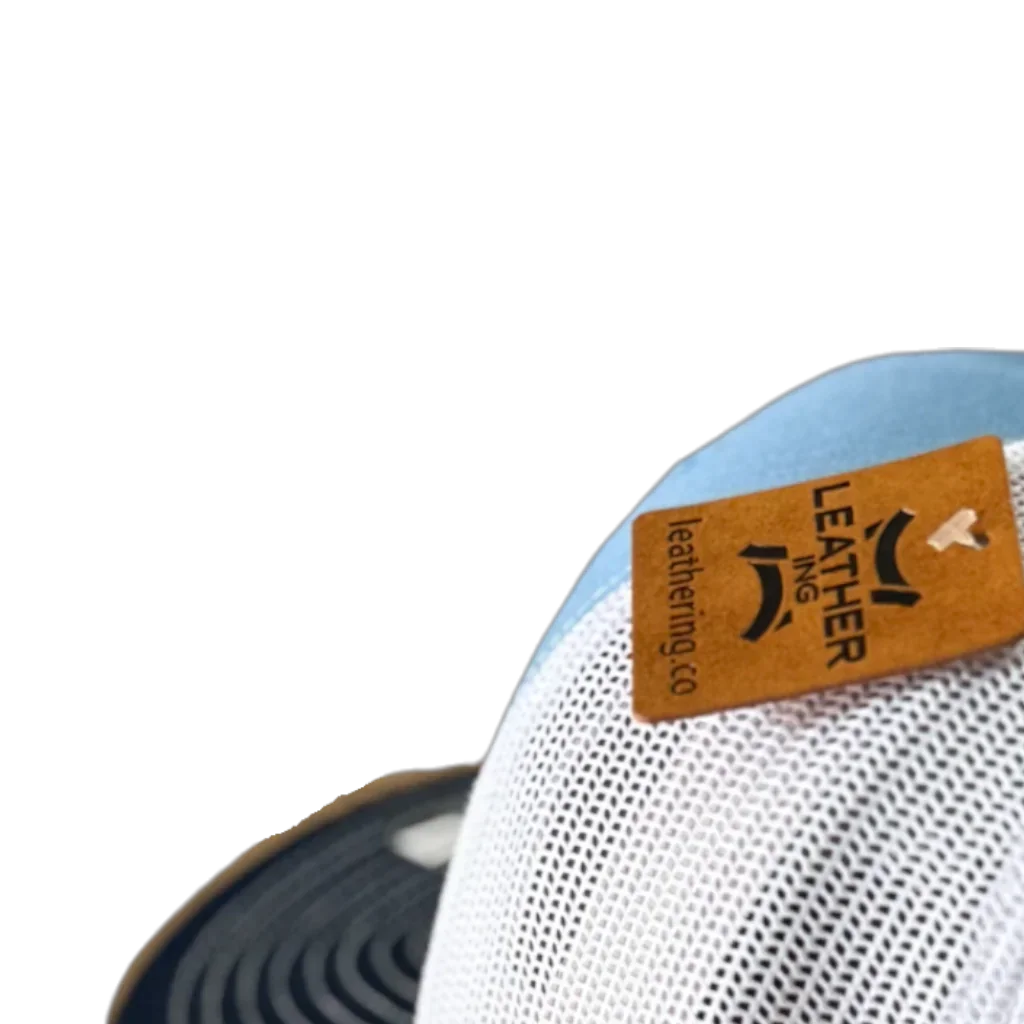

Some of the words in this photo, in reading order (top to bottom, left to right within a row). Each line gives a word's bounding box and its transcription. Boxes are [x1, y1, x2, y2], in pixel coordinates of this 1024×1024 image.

[660, 518, 703, 695] leathering.co
[792, 555, 819, 604] ING
[814, 481, 867, 668] LEATHER
